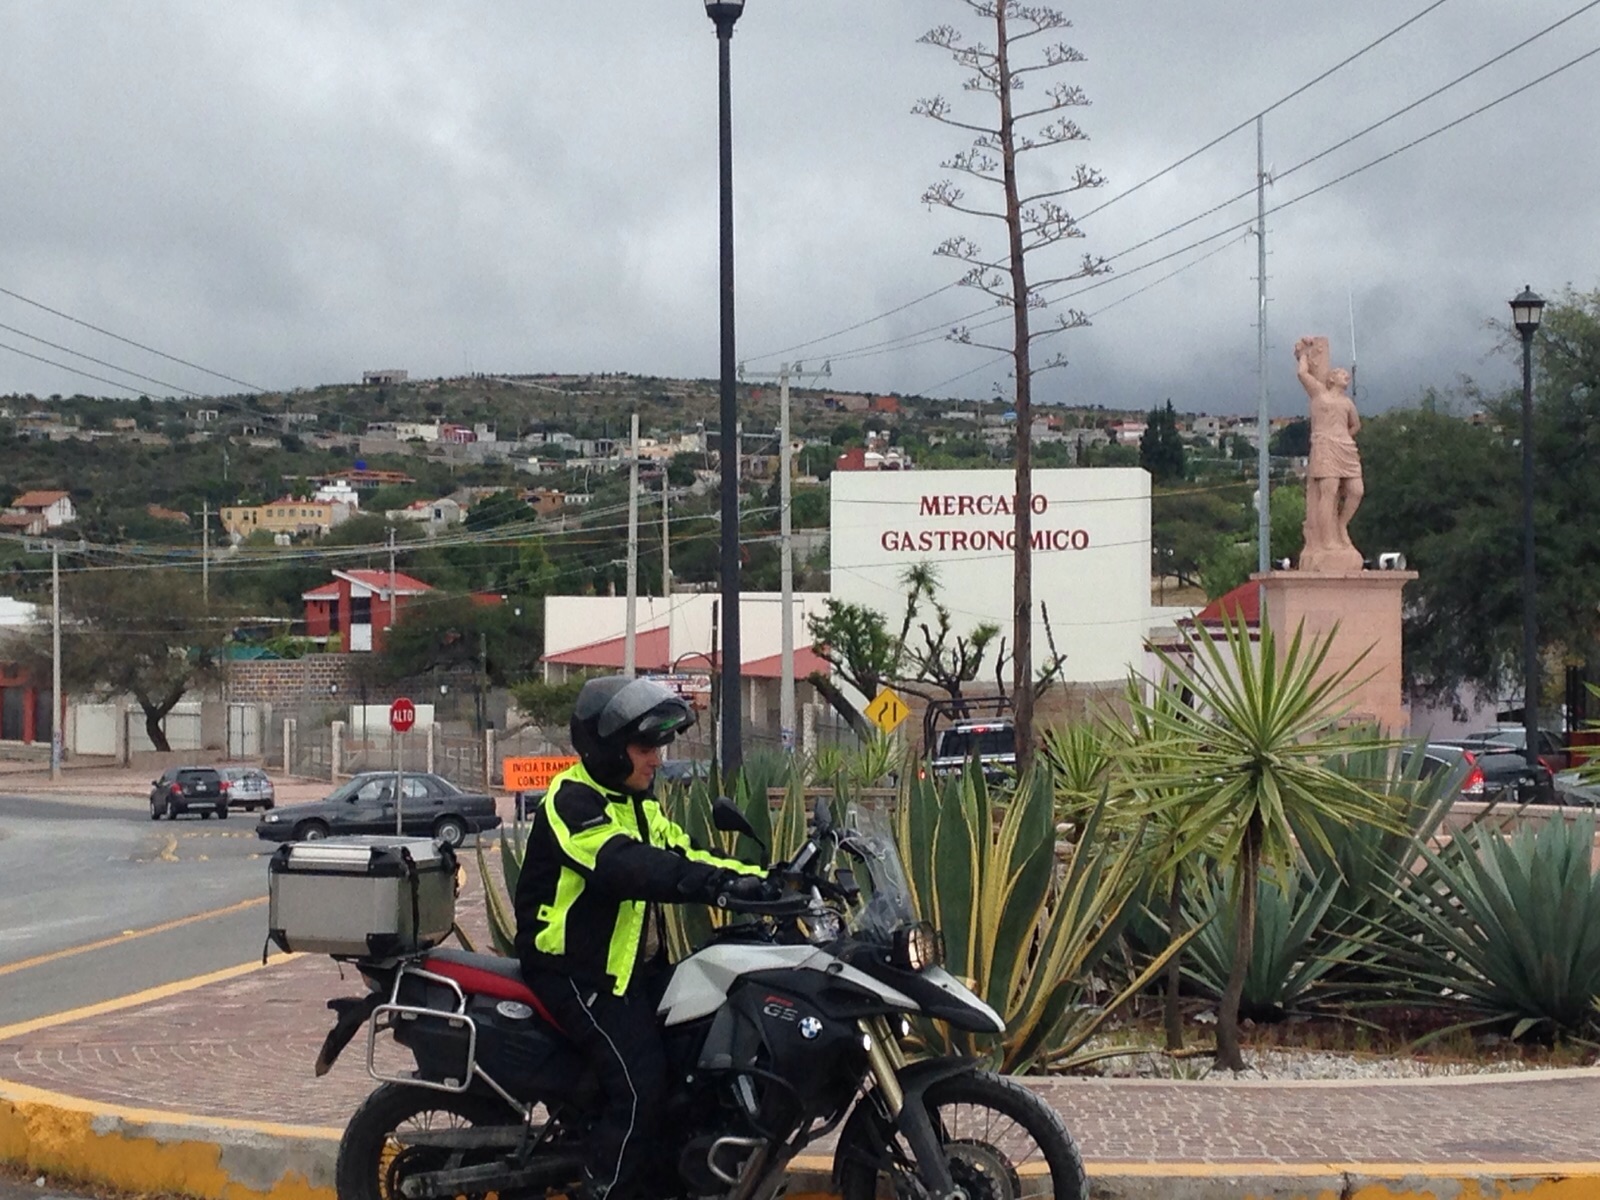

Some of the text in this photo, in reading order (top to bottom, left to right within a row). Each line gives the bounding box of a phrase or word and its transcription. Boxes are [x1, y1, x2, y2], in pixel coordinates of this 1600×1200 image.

[919, 494, 1048, 516] MERCAO
[393, 709, 413, 722] ALTO
[513, 762, 538, 773] INICIA
[763, 1003, 798, 1021] GS
